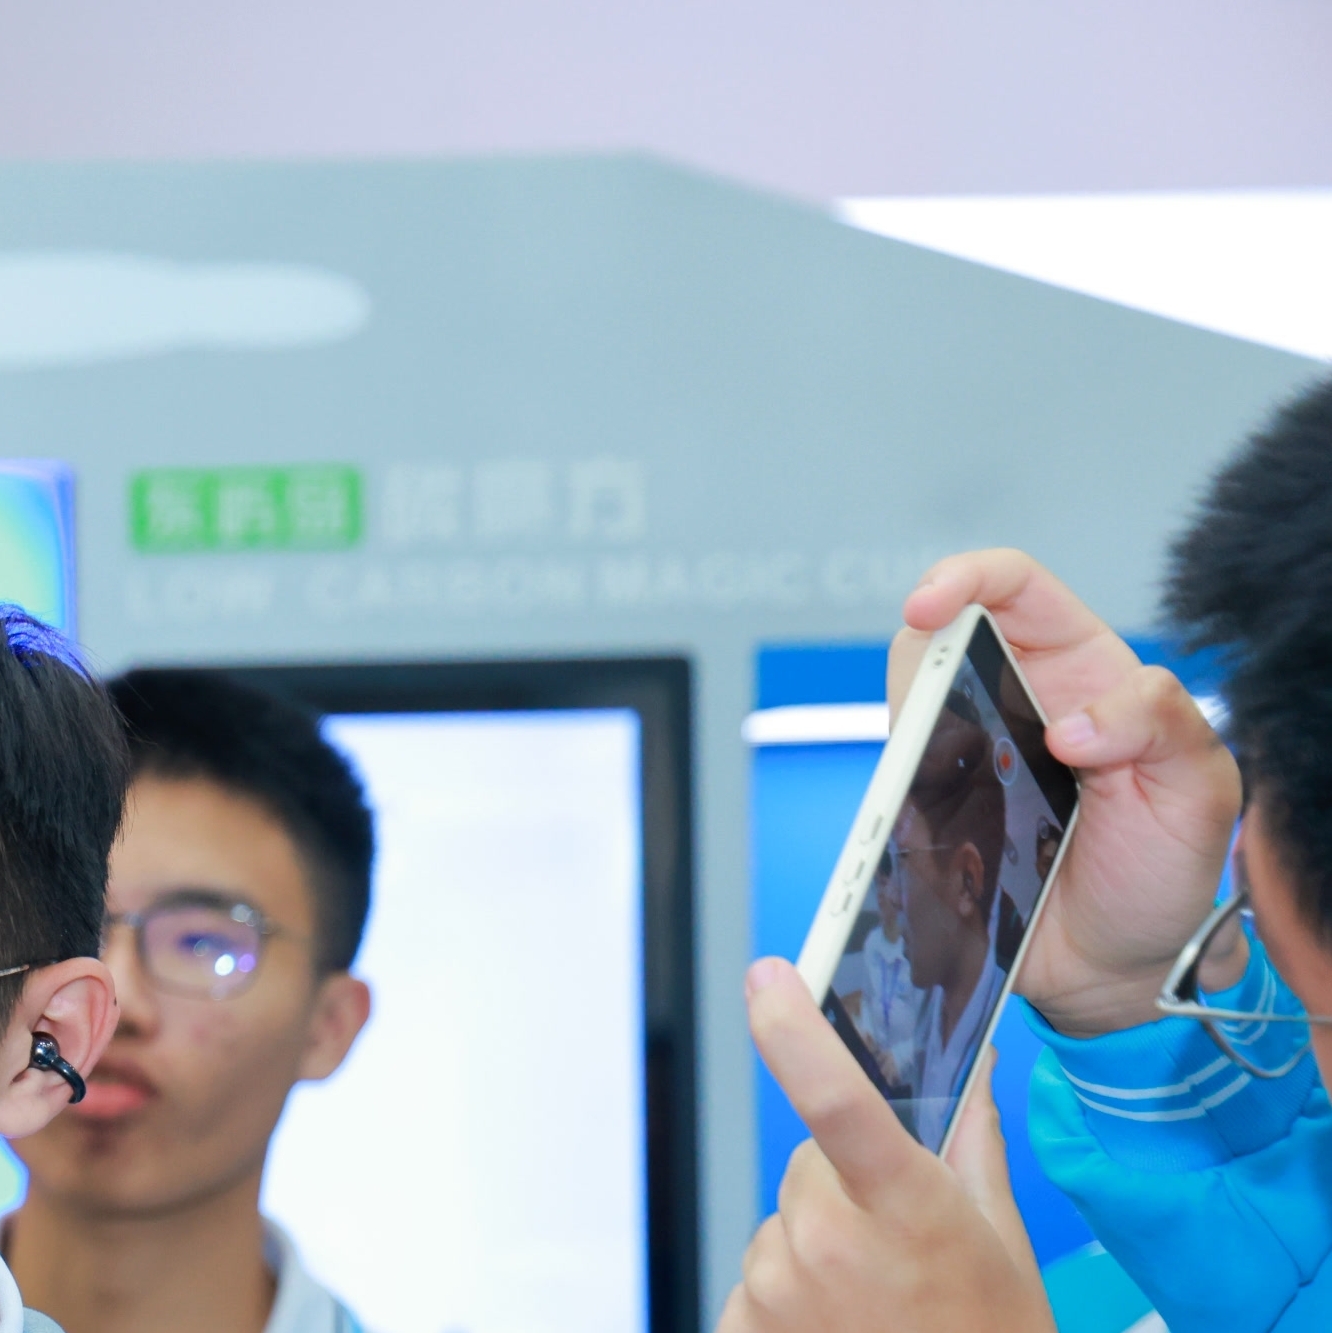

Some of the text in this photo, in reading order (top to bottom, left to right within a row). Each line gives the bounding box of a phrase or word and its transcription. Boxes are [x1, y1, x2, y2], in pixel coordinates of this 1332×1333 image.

[125, 566, 274, 624] LOW
[308, 557, 587, 617] CARBON
[597, 550, 811, 610] MAGIC
